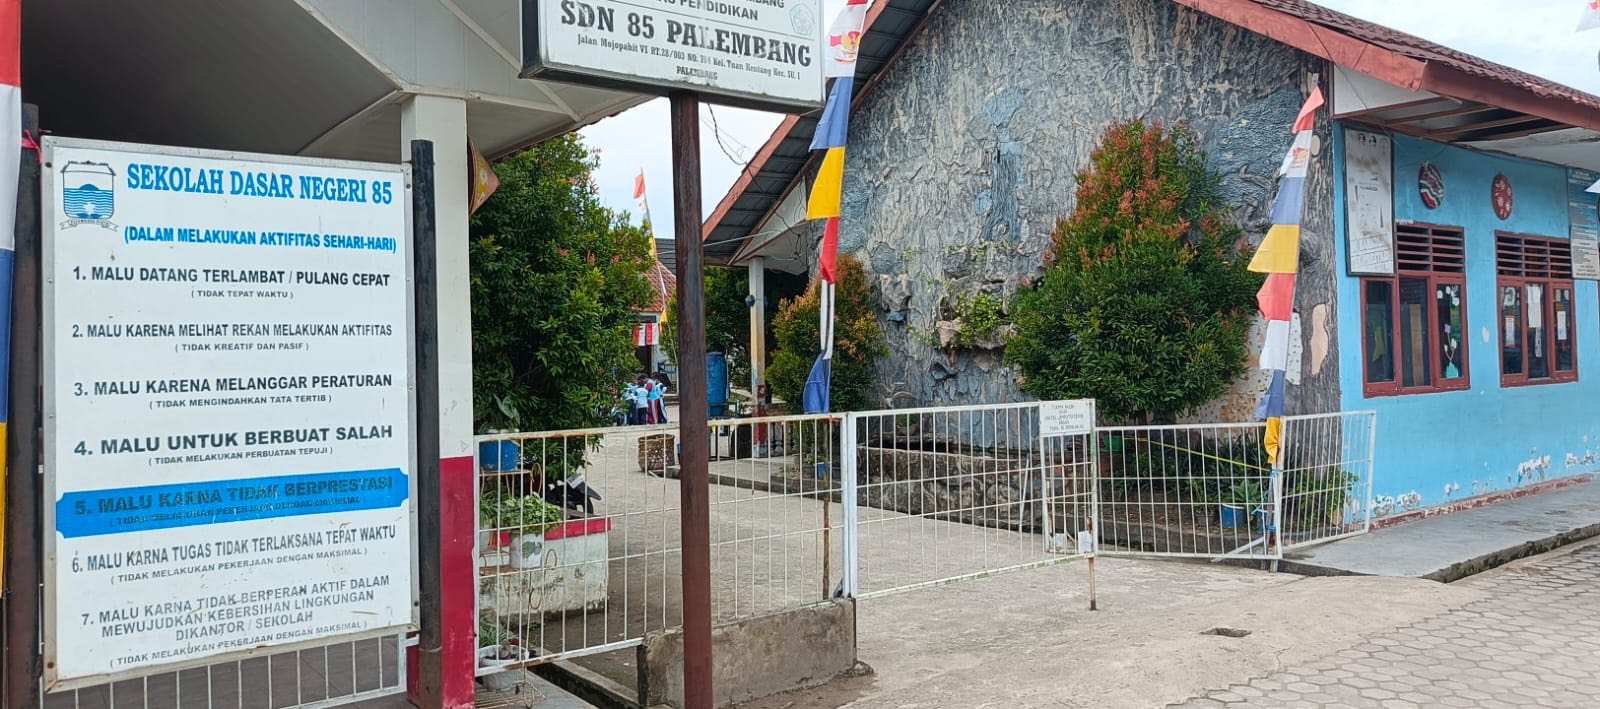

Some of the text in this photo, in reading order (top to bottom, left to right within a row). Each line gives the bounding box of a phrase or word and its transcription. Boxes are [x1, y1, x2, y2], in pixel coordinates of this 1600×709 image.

[680, 0, 758, 20] PENDIDIKAN
[561, 0, 811, 67] SDN 85 PALEMBANG
[578, 34, 598, 46] Jalan
[640, 44, 648, 54] VI
[127, 163, 392, 204] SEKOLAH DASAR NEGERI 85
[124, 225, 396, 254] (DALAM MELAKUKAN AKTIFITAS SEHARI-HARI)
[73, 266, 86, 281] 1.
[92, 266, 134, 282] MALU
[140, 268, 198, 283] DATANG
[202, 270, 285, 284] TERLAMBAT
[296, 271, 348, 286] PULANG
[352, 273, 390, 287] CEPAT
[228, 290, 254, 298] TEPAT
[72, 324, 392, 338] 2. MALU KARENA MELIHAT REKAN MELAKUKAN AKTIFITAS
[278, 342, 304, 350] PASIF
[74, 374, 392, 396] 3. MALU KARENA MELANGGAR PERATURAN
[156, 400, 186, 408] TIDAK
[189, 396, 268, 407] MENGINDAHKAN
[270, 396, 292, 404] TATA
[295, 394, 326, 403] TERTIB
[74, 424, 392, 456] 4. MALU UNTUK BERBUAT SALAH
[155, 456, 182, 465] TIDAK
[186, 452, 243, 463] MELAKUKAN
[246, 448, 296, 460] PERBUATAN
[298, 446, 328, 457] TEPUJI
[74, 475, 393, 515] 5. MALU KARNA TIDAK BERPRESTASI
[72, 524, 396, 573] 6. MALU KARNA TUGAS TIDAK TERLAKSANA TEPAT WAKTU
[118, 572, 149, 582] TIDAK
[152, 564, 215, 578] MELAKUKAN
[218, 558, 274, 570] PEKERJAAN
[276, 554, 314, 564] DENGAN
[82, 575, 389, 626] 7. MALU KARNA TIDAK BERPERAN AKTIF DALAM
[102, 590, 374, 638] MEWUJUDKAN KEBERSIHAN LINGKUNGAN
[176, 620, 244, 641] DIKANTOR
[256, 612, 313, 629] SEKOLAH
[118, 654, 148, 666] TIDAK
[276, 630, 313, 640] DENGAN
